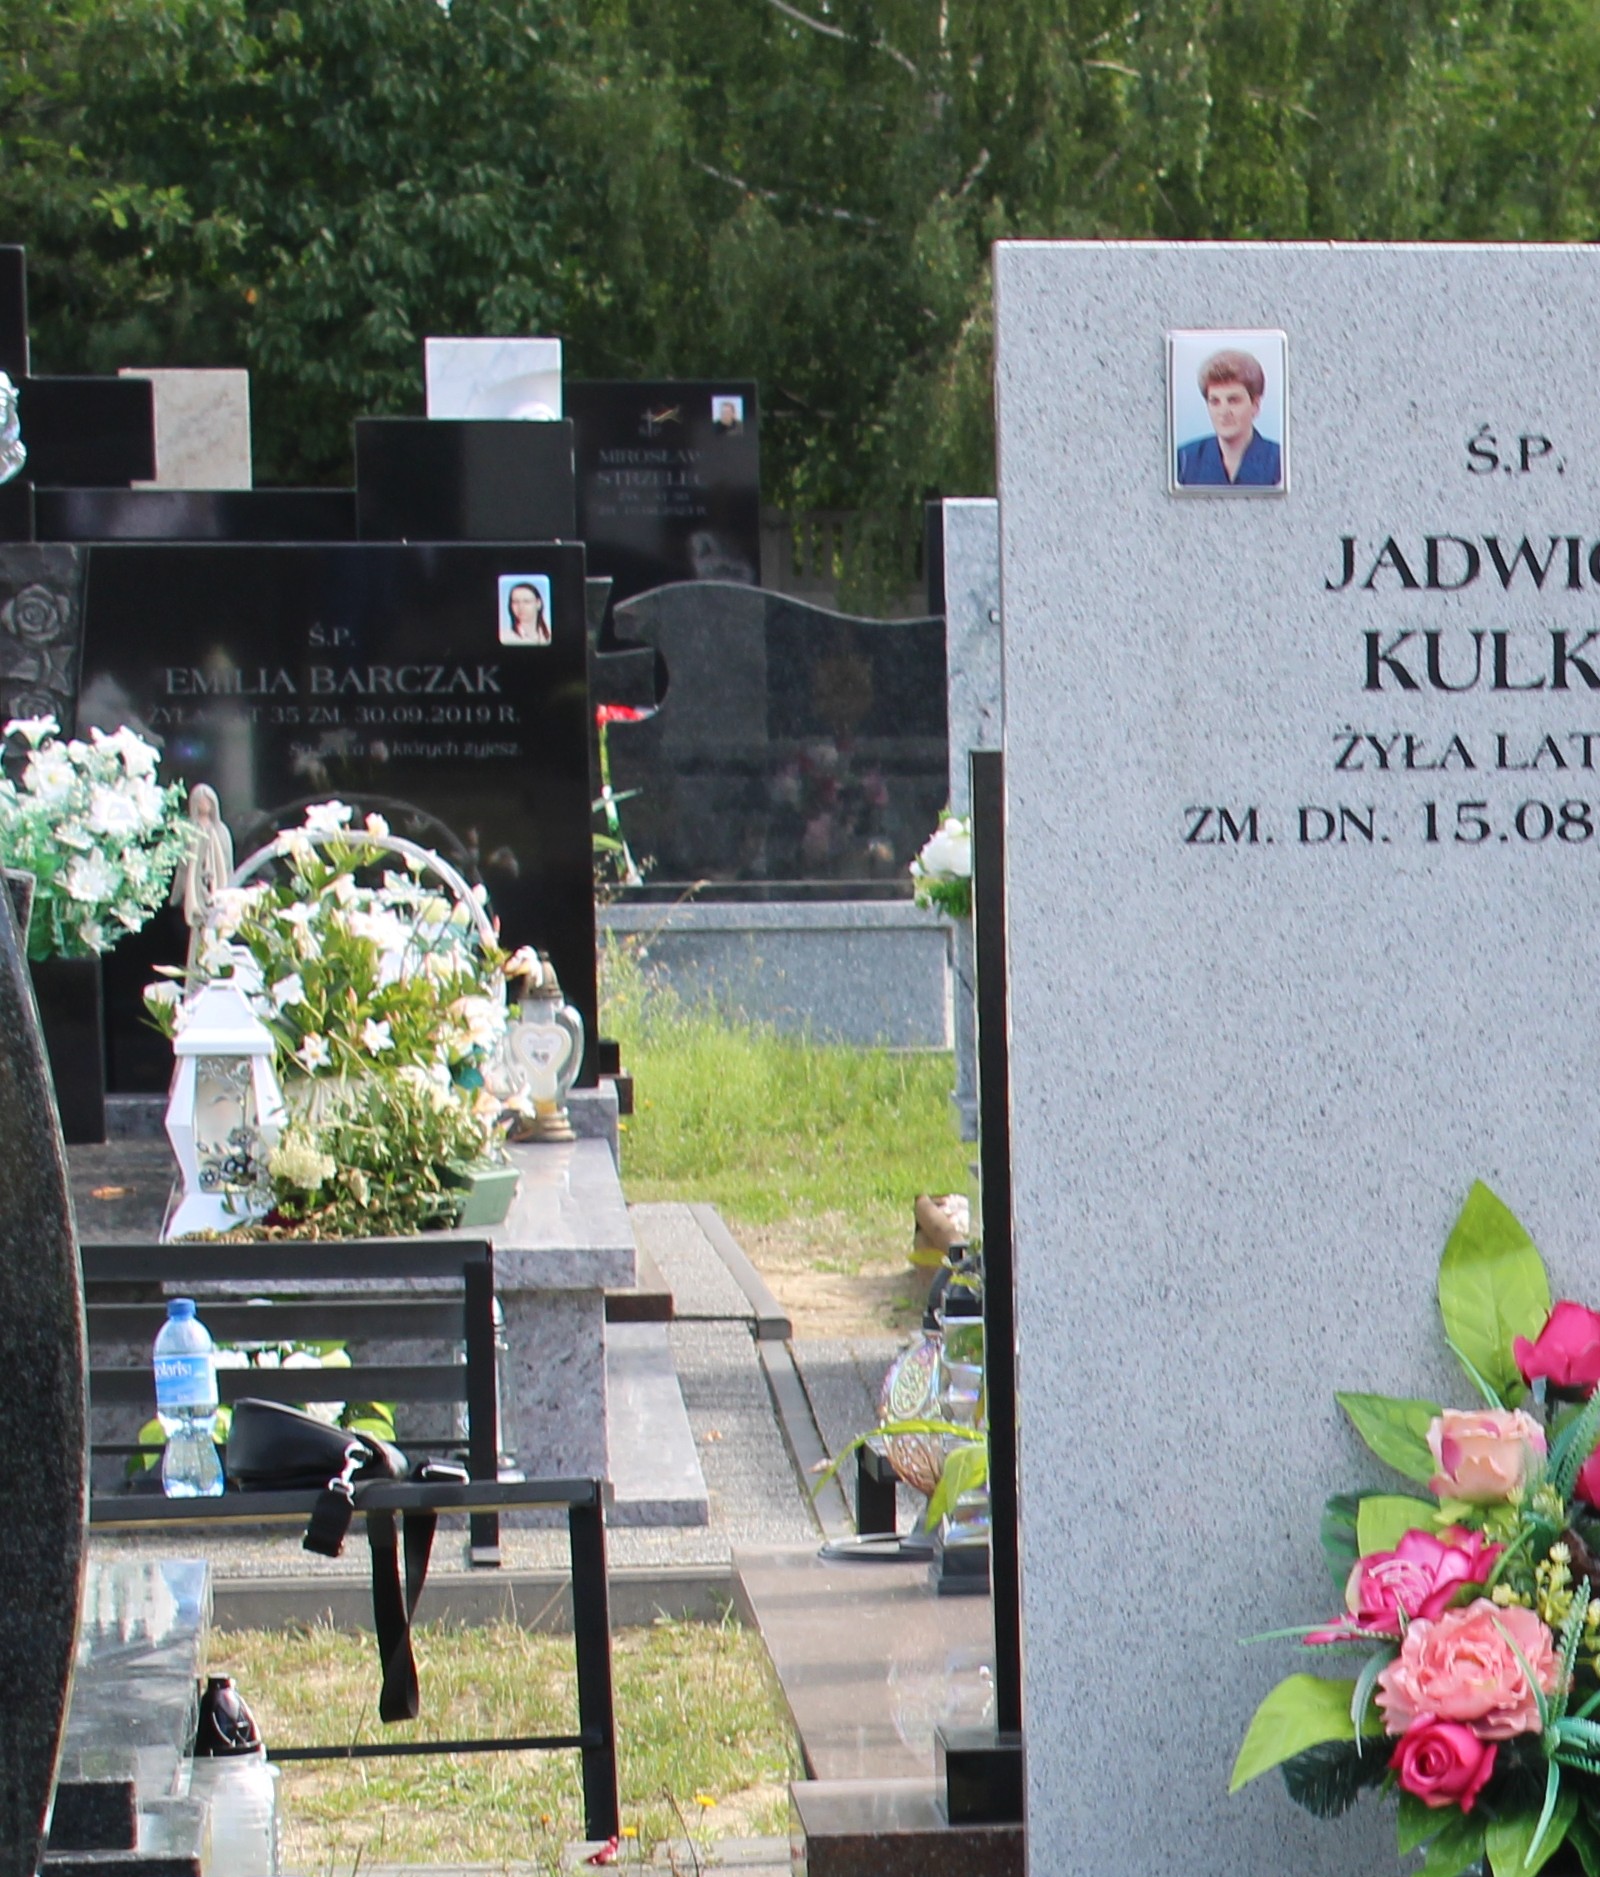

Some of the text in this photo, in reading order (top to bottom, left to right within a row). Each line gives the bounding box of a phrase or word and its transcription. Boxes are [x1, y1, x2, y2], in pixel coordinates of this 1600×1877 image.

[1466, 424, 1565, 475] Ś.P.
[308, 622, 357, 647] Ś.P.
[165, 666, 501, 695] EMILIA BARCZAK
[270, 706, 300, 724] 35
[356, 706, 491, 725] 30.09.2019
[500, 706, 521, 725] R.
[1333, 724, 1476, 770] ŻYŁA
[1184, 805, 1274, 844] ZM.
[1297, 805, 1392, 844] DN.
